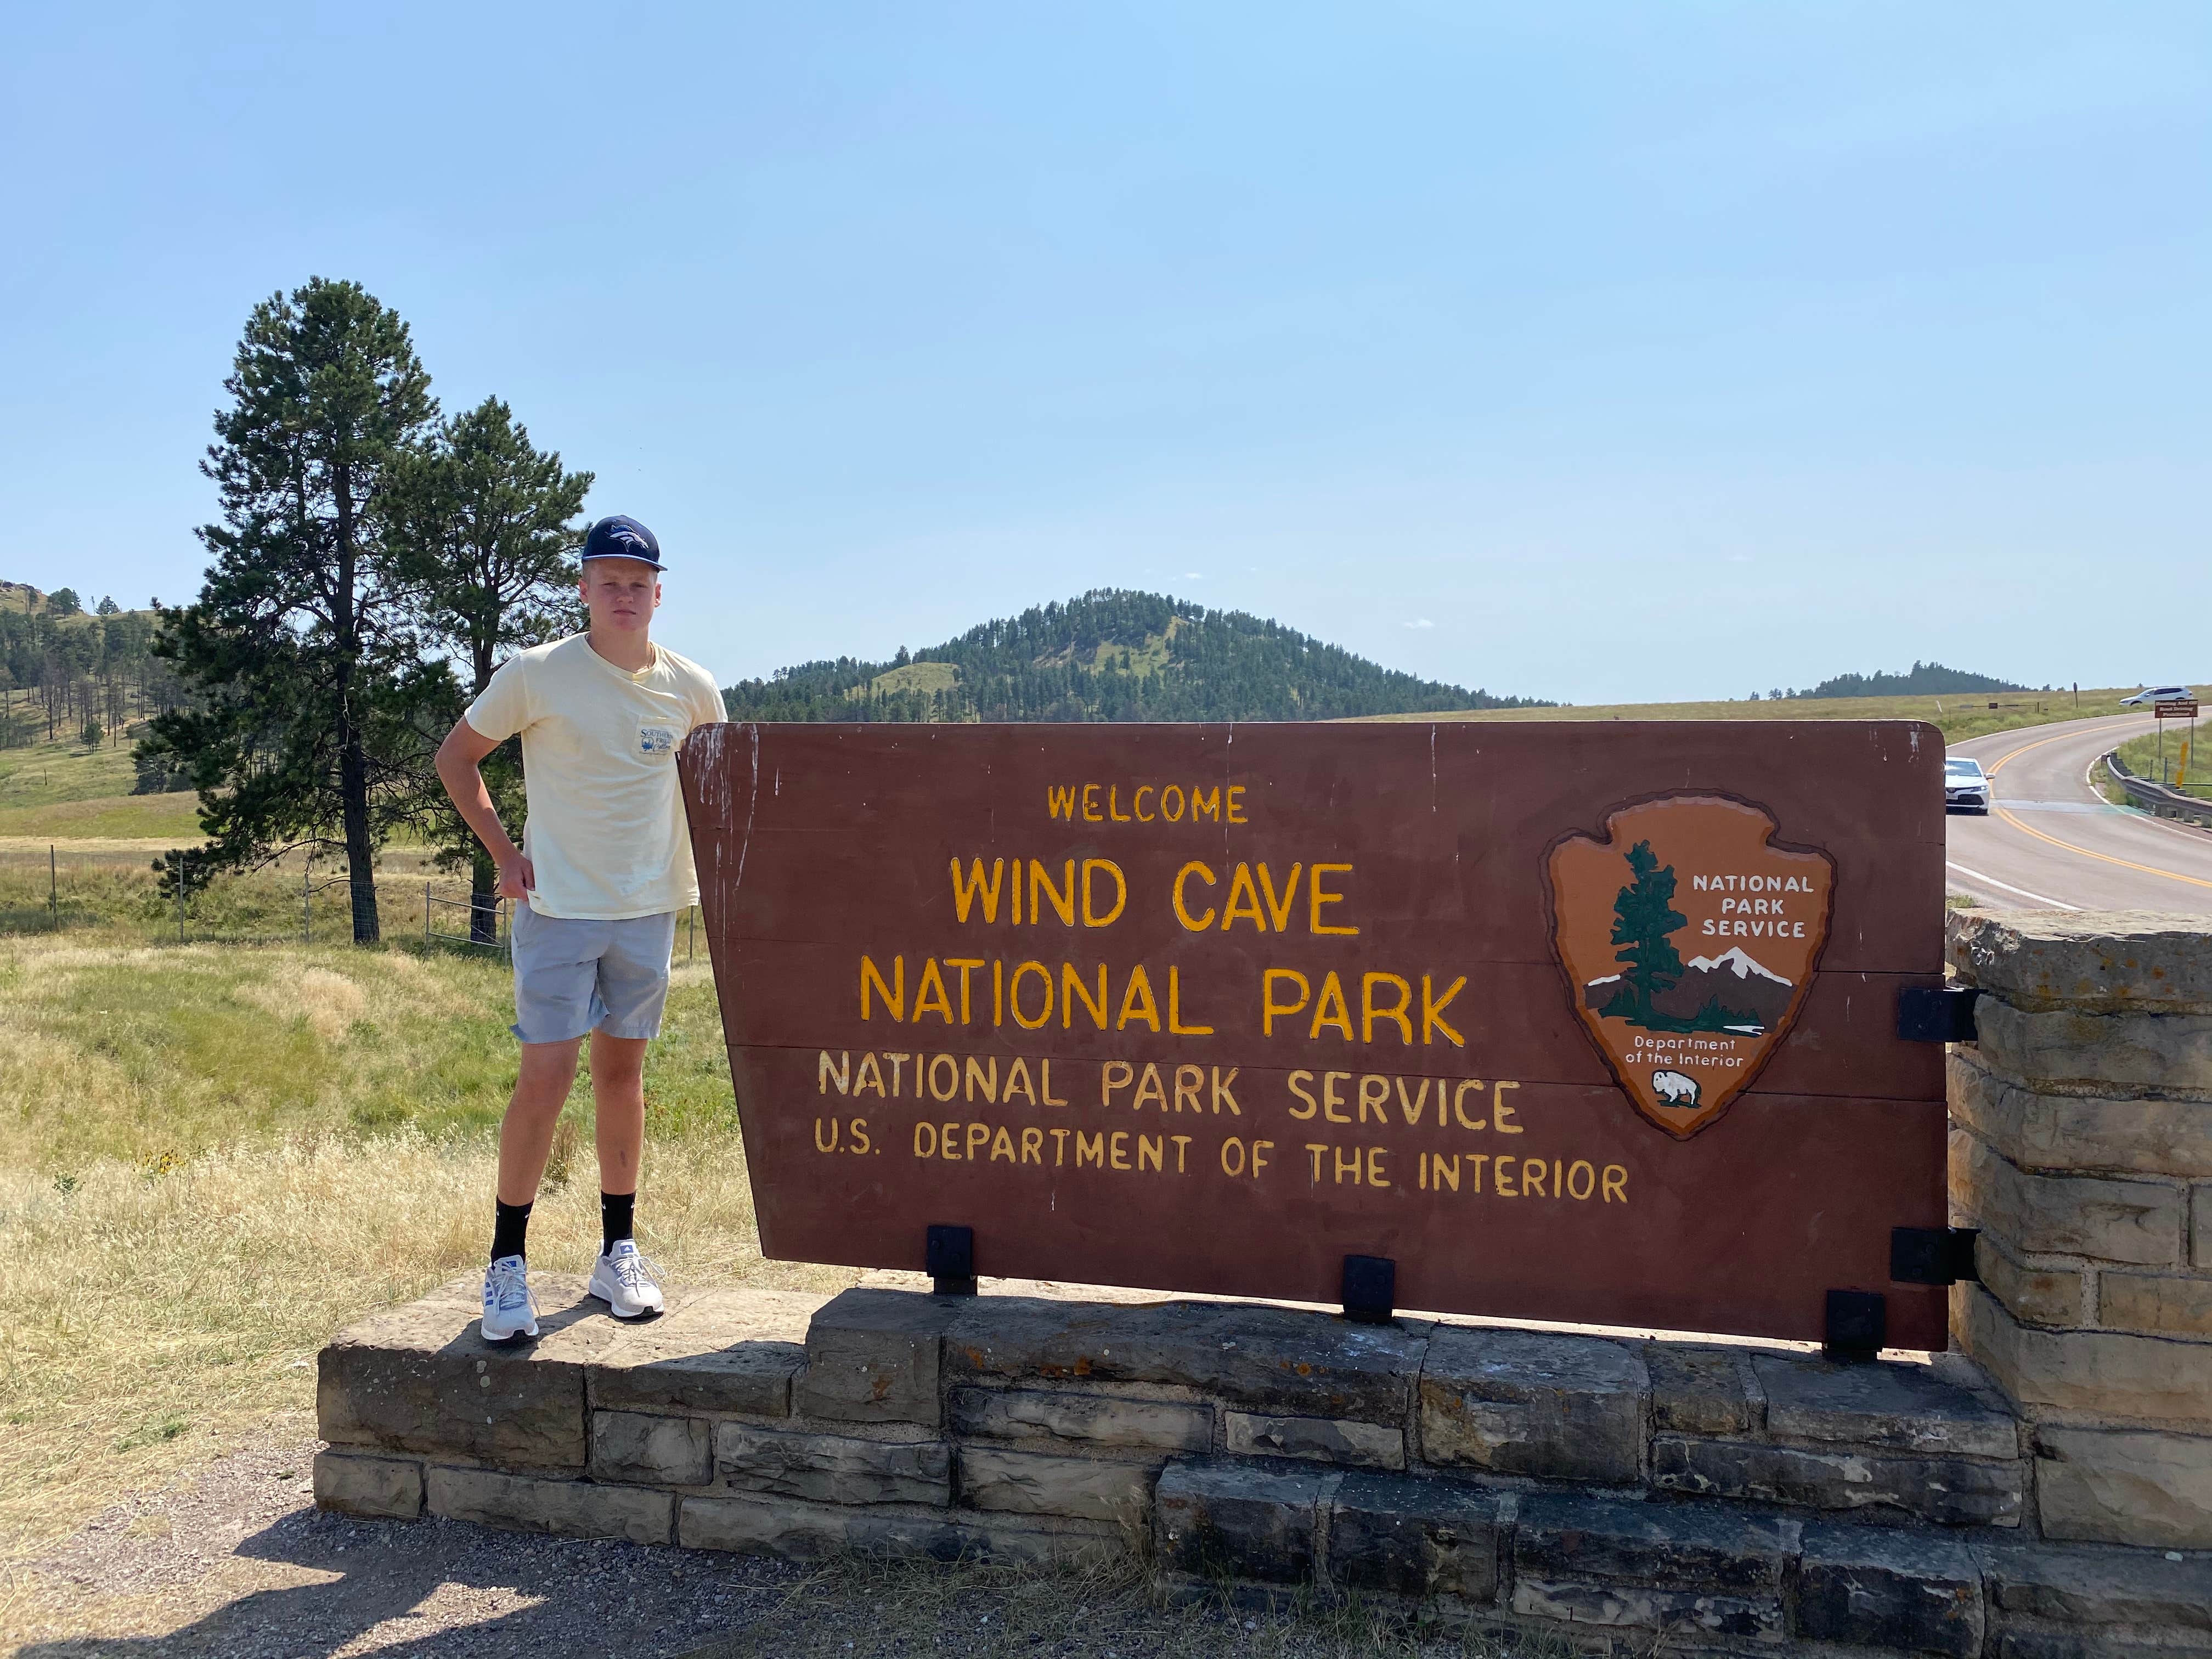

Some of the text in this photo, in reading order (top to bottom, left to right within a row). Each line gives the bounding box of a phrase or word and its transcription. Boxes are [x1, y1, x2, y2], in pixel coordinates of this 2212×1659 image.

[1048, 784, 1249, 825] WELCOME
[950, 856, 1361, 935] WIND CAVE
[1693, 875, 1814, 893] NATIONAL
[1722, 898, 1785, 915] PARK
[1701, 919, 1805, 939] SERVICE
[860, 954, 1469, 1049] NATIONAL PARK
[1634, 1035, 1736, 1052] Department
[1625, 1050, 1744, 1068] of the Interior
[818, 1050, 1525, 1136] NATIONAL PARK SERVICE
[815, 1118, 1630, 1205] U.S. DEPARTMENT OF THE INTERIOR
